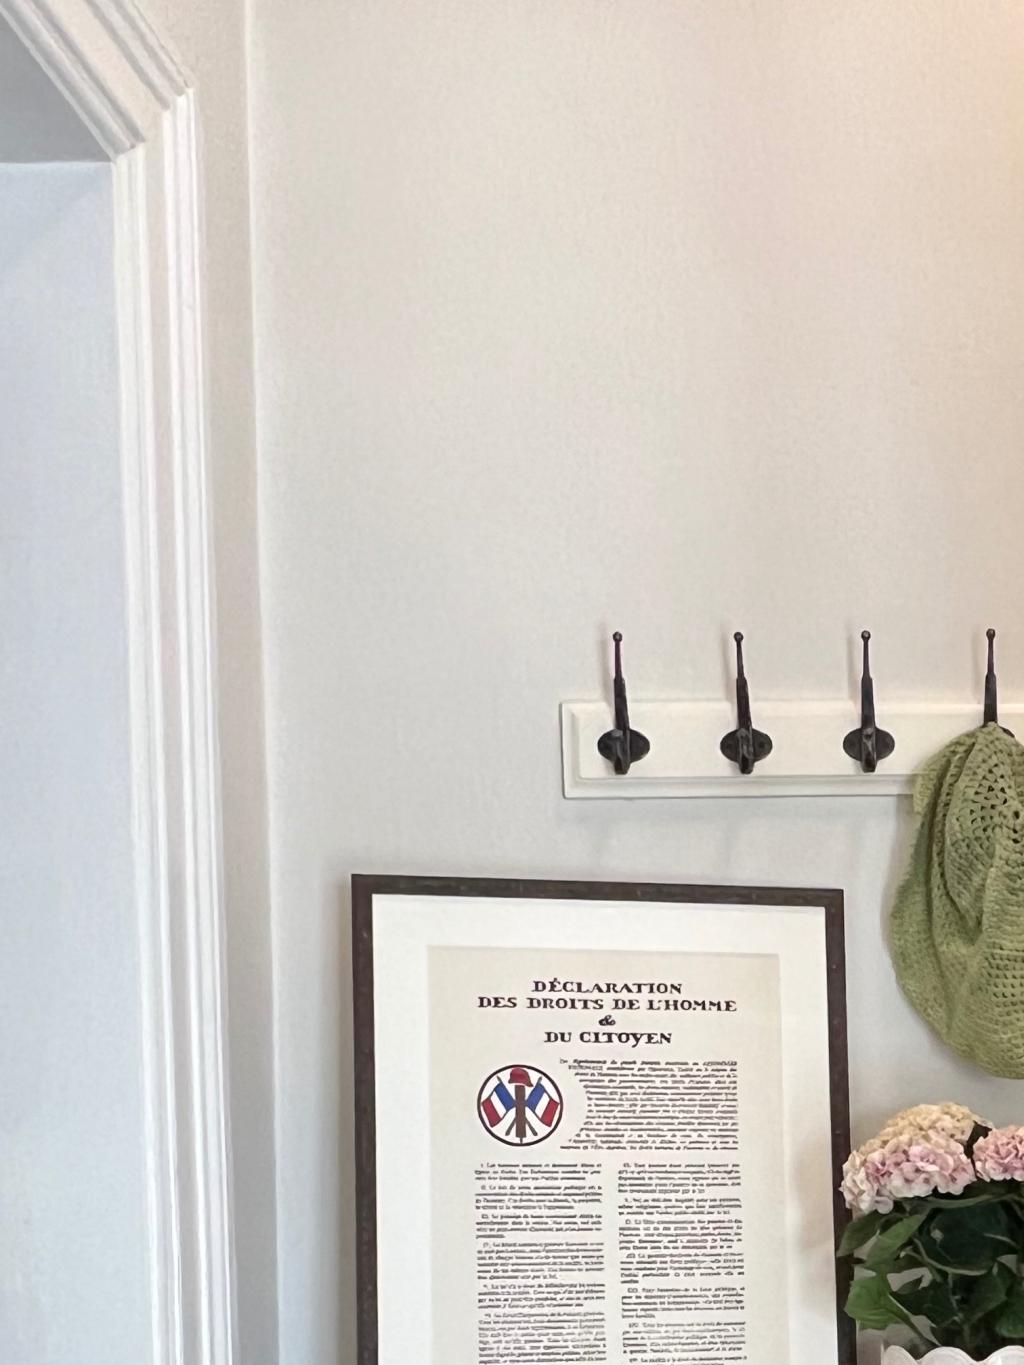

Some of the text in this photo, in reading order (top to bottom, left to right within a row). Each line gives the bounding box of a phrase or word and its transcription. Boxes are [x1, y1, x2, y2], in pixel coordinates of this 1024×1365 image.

[531, 977, 683, 995] DÉCLARATION
[477, 996, 737, 1012] DES DROITS DE L'HOMME
[598, 1014, 617, 1027] &
[543, 1031, 672, 1049] DU CITOYEN
